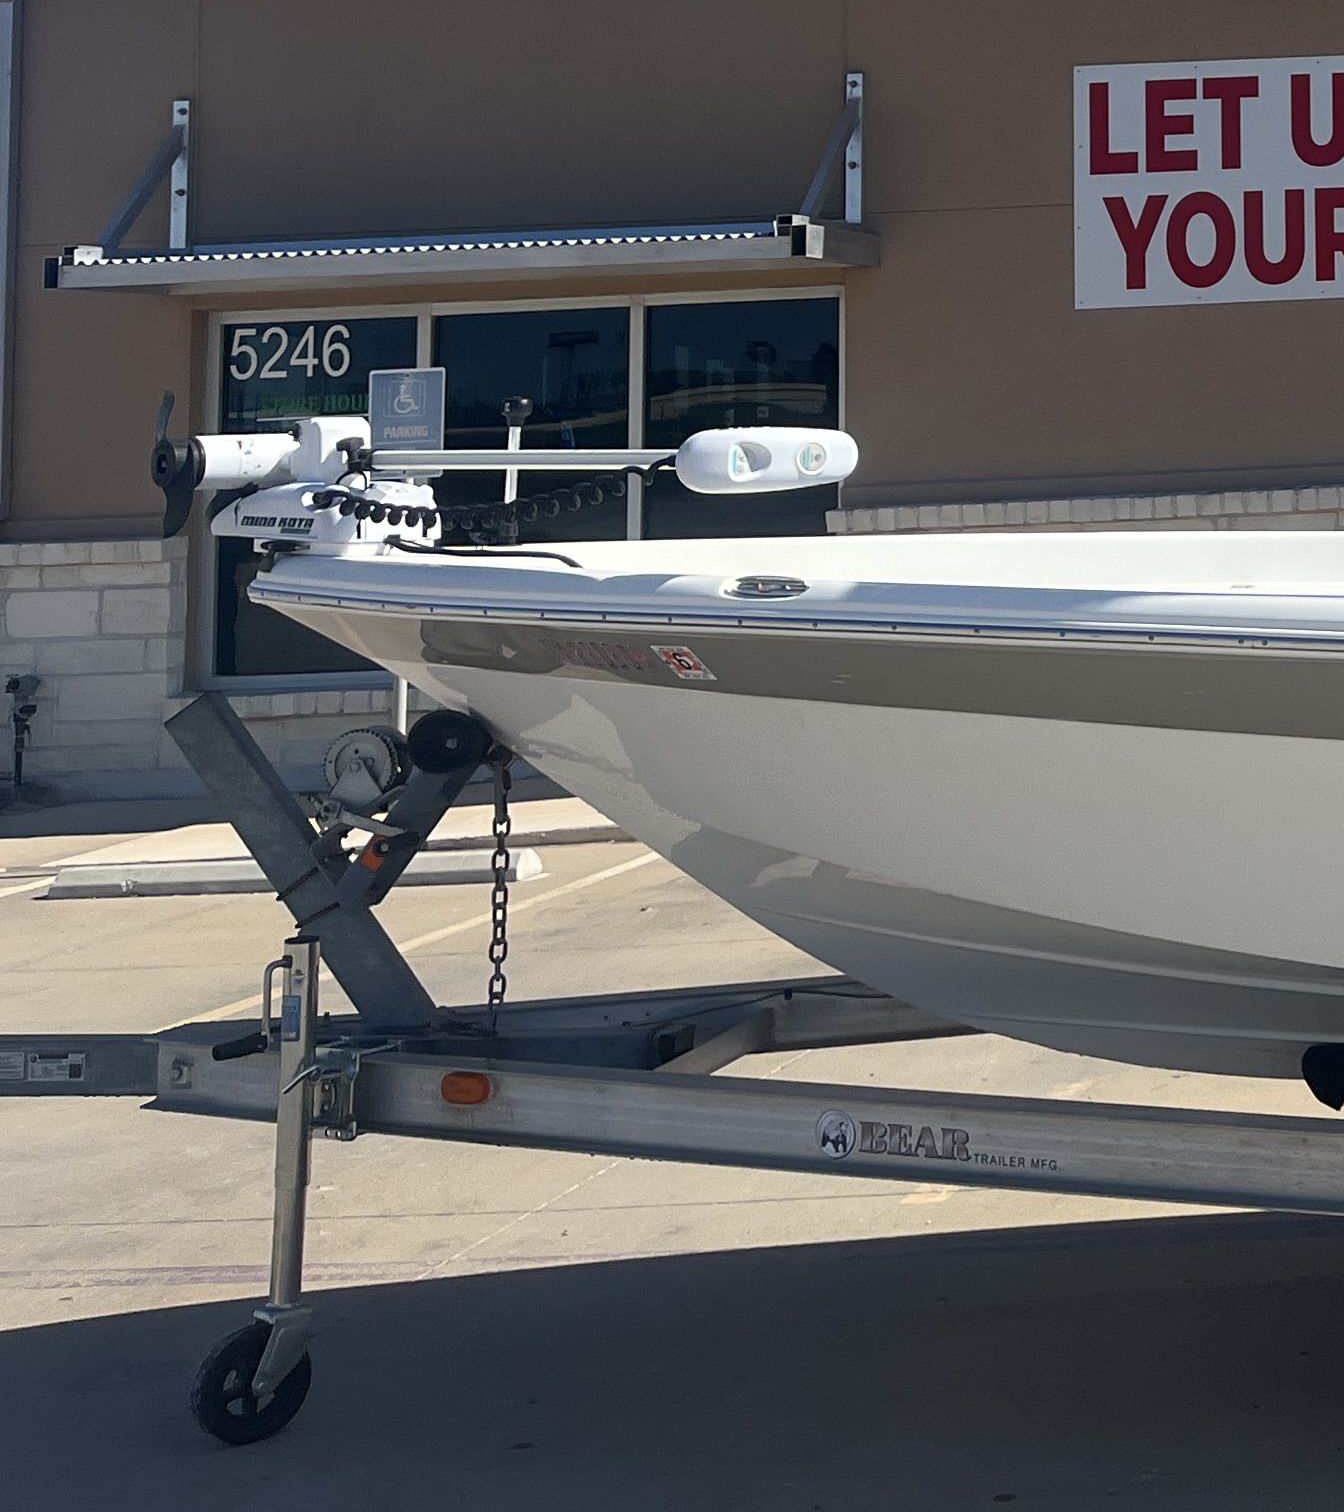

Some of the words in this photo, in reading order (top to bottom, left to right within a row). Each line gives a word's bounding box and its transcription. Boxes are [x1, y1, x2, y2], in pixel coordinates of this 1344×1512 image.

[1088, 75, 1260, 176] LET
[229, 324, 350, 381] 5246
[278, 517, 314, 528] KOTA
[858, 1121, 972, 1162] BEAR
[973, 1154, 1026, 1168] TRAILER
